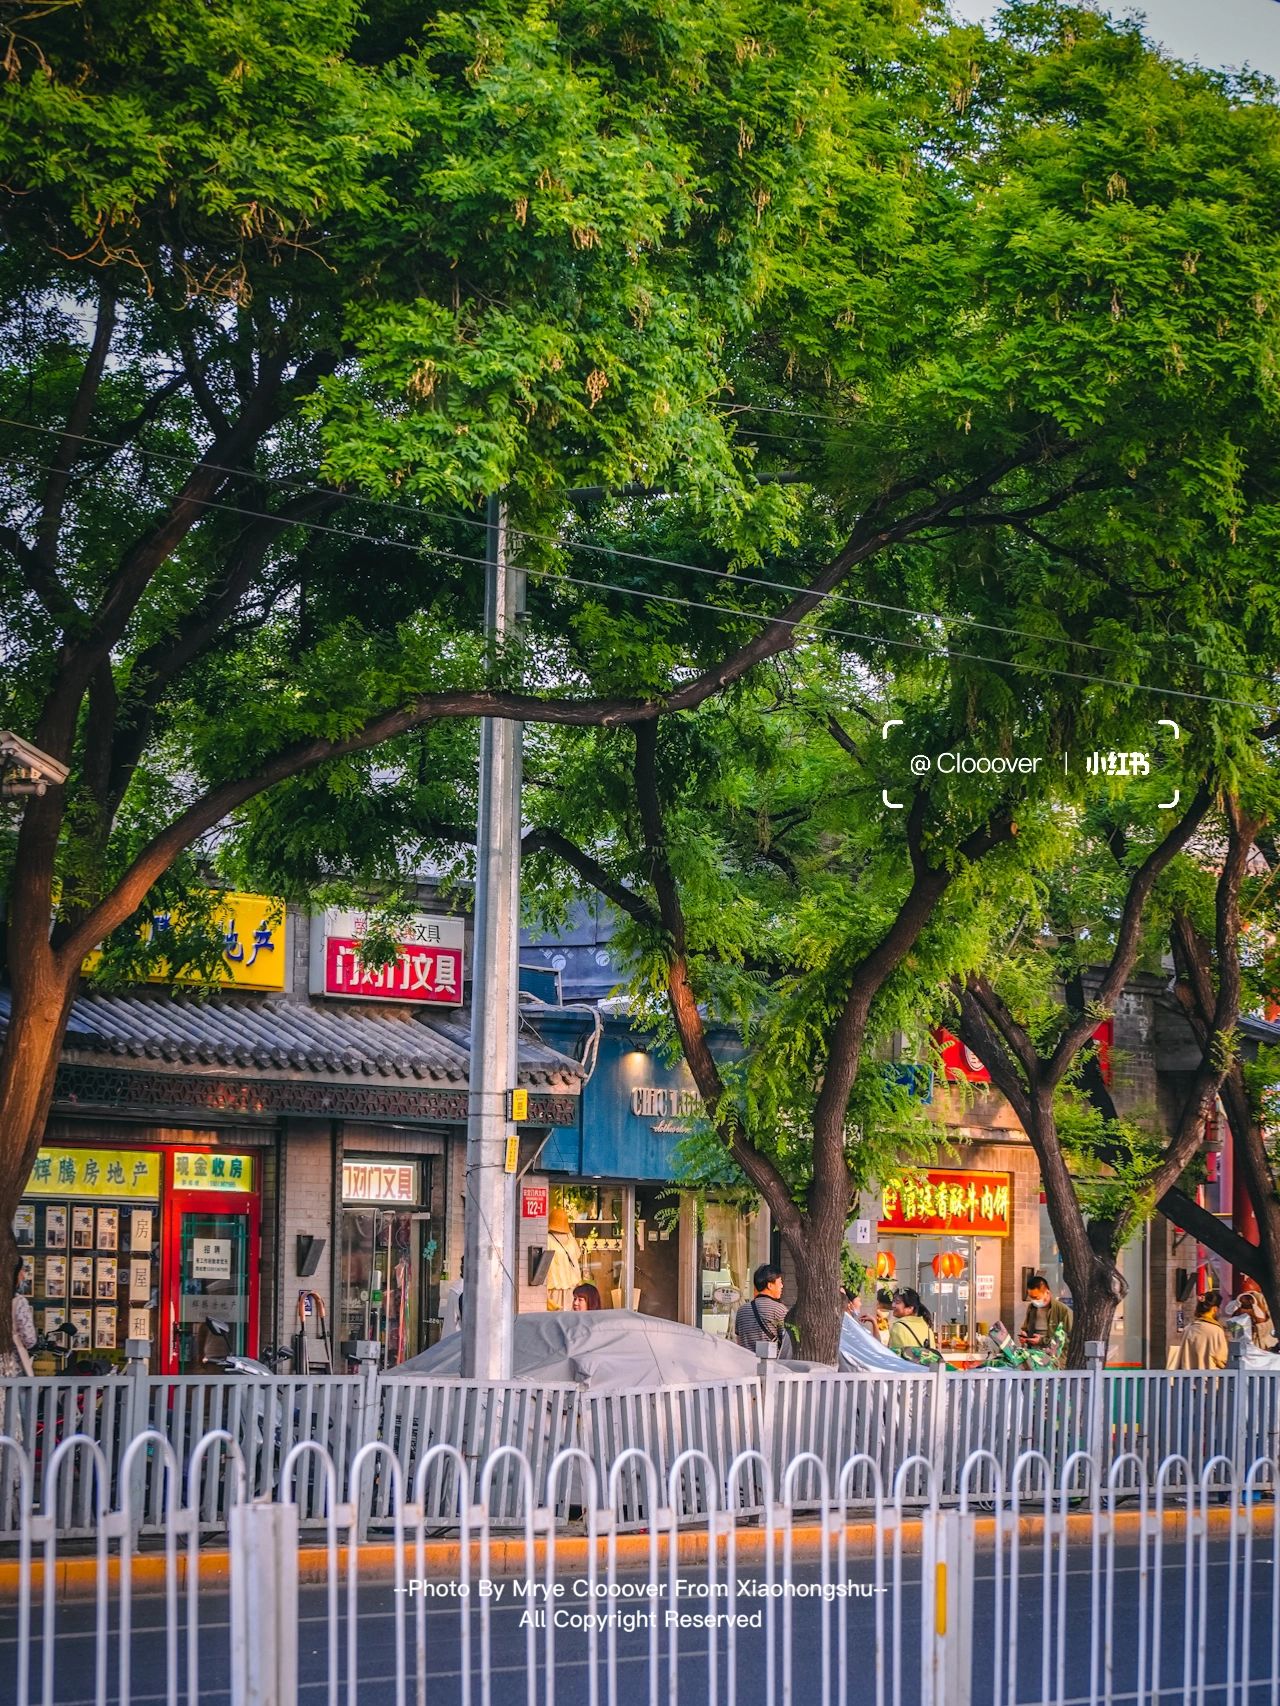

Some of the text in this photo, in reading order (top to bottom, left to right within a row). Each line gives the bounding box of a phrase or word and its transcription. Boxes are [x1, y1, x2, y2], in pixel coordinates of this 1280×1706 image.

[632, 1087, 668, 1117] CHIC
[34, 1157, 148, 1187] 辉腾房地产
[176, 1156, 243, 1179] 现金收房
[527, 1201, 543, 1215] 122-1
[137, 1219, 149, 1239] 房
[136, 1267, 147, 1288] 屋
[131, 1317, 146, 1336] 租
